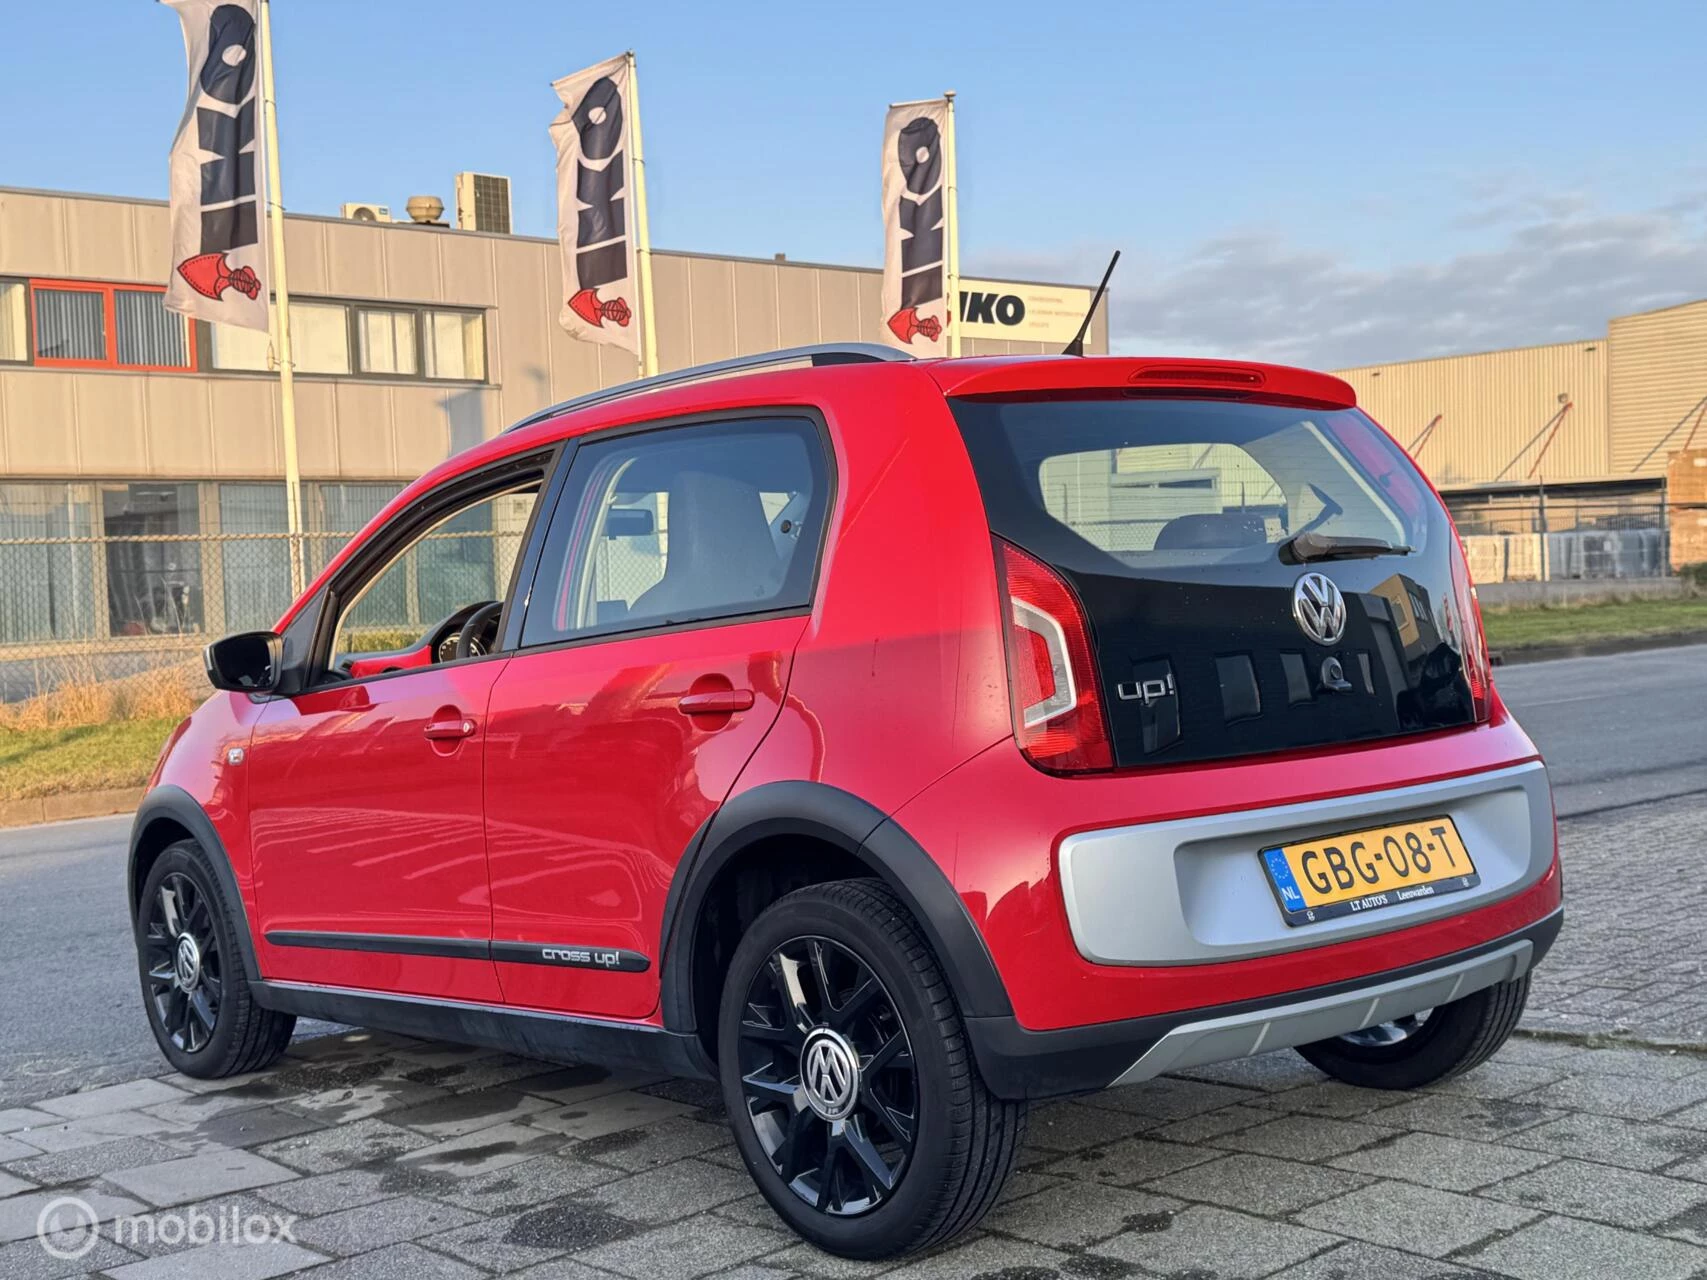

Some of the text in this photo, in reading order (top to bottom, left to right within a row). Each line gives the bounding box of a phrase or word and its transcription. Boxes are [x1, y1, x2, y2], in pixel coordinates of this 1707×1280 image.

[196, 3, 259, 253] IKO
[571, 76, 628, 290] IKO
[897, 116, 944, 310] IKO
[1117, 673, 1176, 706] up!
[1281, 886, 1301, 902] NL
[1301, 826, 1456, 895] GBG-08-T
[541, 948, 621, 968] cross up!
